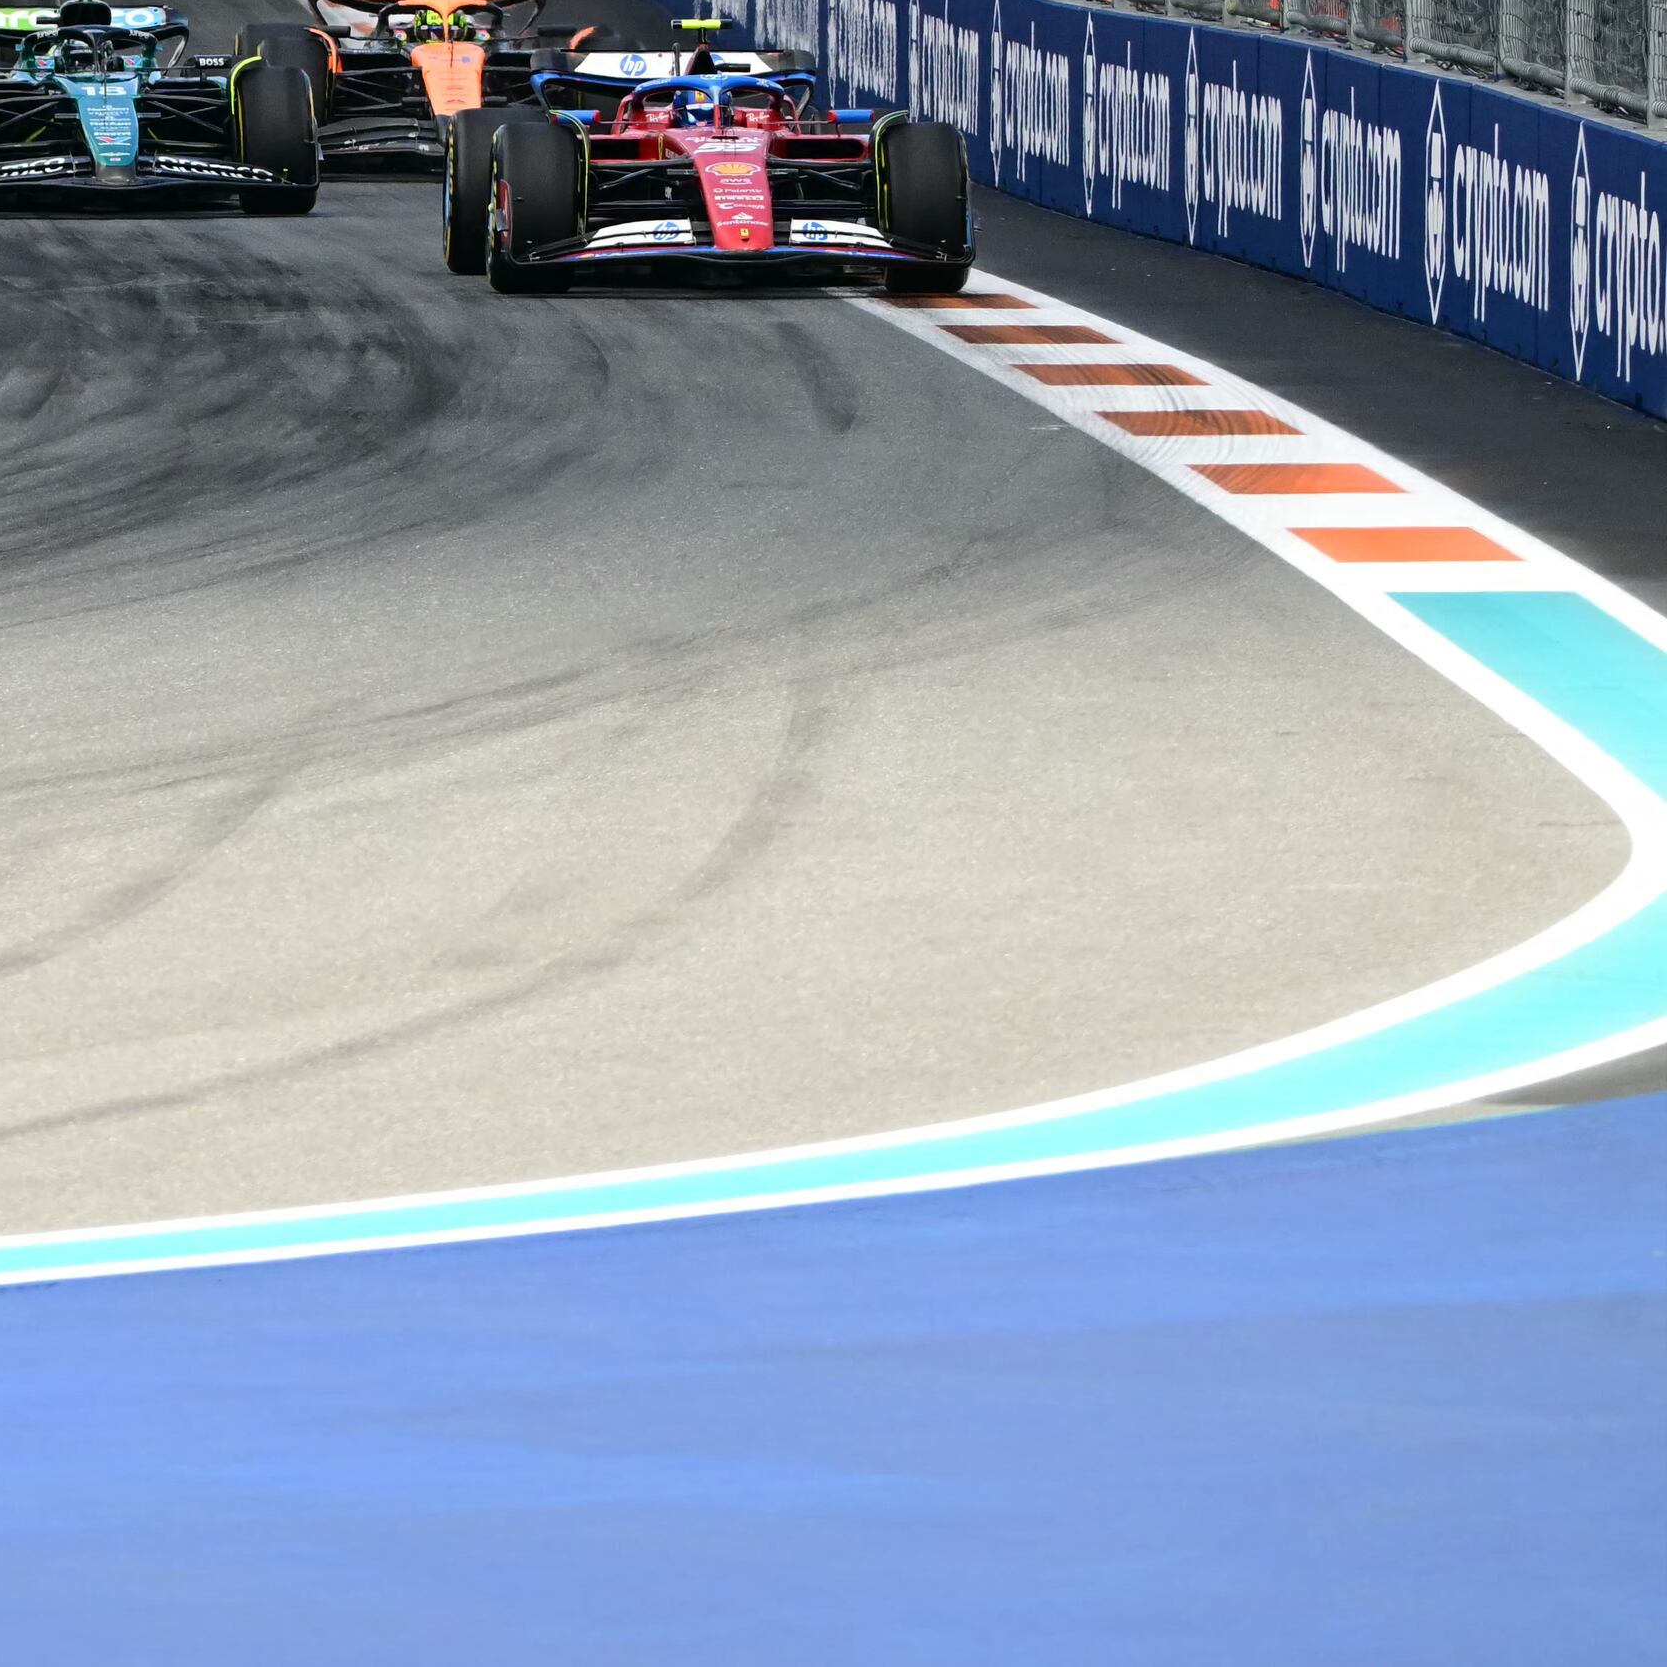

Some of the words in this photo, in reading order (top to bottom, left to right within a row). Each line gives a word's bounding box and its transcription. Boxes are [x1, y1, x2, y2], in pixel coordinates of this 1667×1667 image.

[81, 87, 127, 96] 18
[199, 58, 224, 67] BOSS
[622, 54, 646, 76] hp
[1099, 41, 1170, 210] crypto.com
[1203, 59, 1283, 238] crypto.com
[1321, 86, 1402, 273] crypto.com
[1452, 122, 1550, 323] crypto.com
[1595, 171, 1667, 383] crypto.
